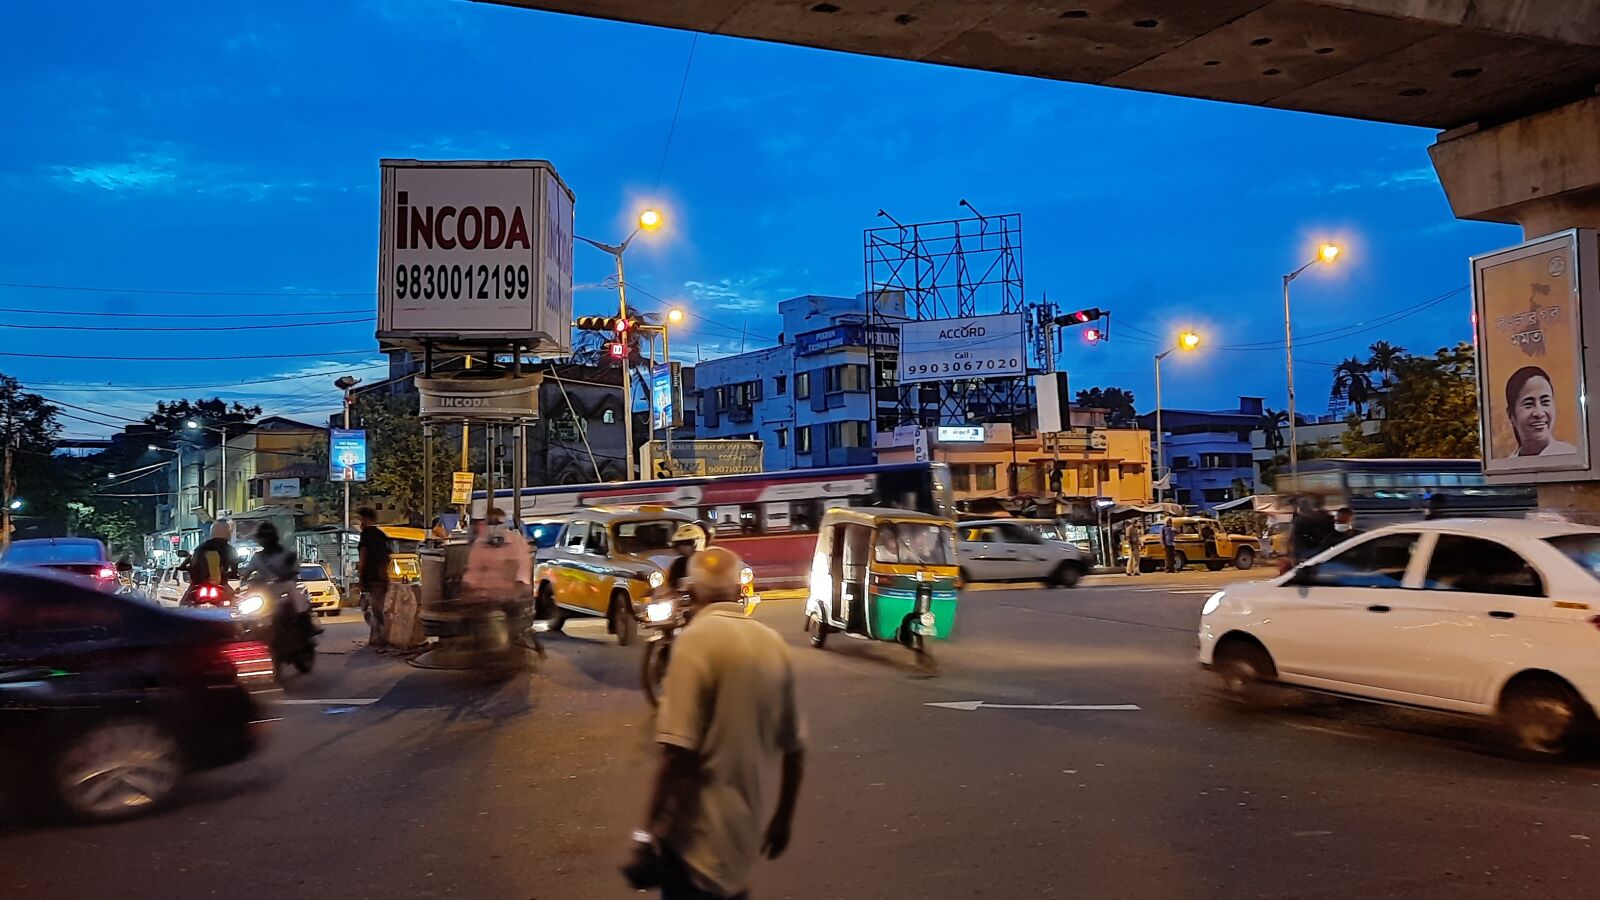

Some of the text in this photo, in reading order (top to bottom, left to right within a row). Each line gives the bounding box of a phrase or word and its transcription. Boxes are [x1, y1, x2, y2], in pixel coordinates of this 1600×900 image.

[396, 264, 529, 300] 9830012199
[939, 327, 986, 340] ACCORD
[954, 352, 969, 360] Call
[908, 358, 1018, 375] 9903067020
[440, 398, 490, 408] INCODA
